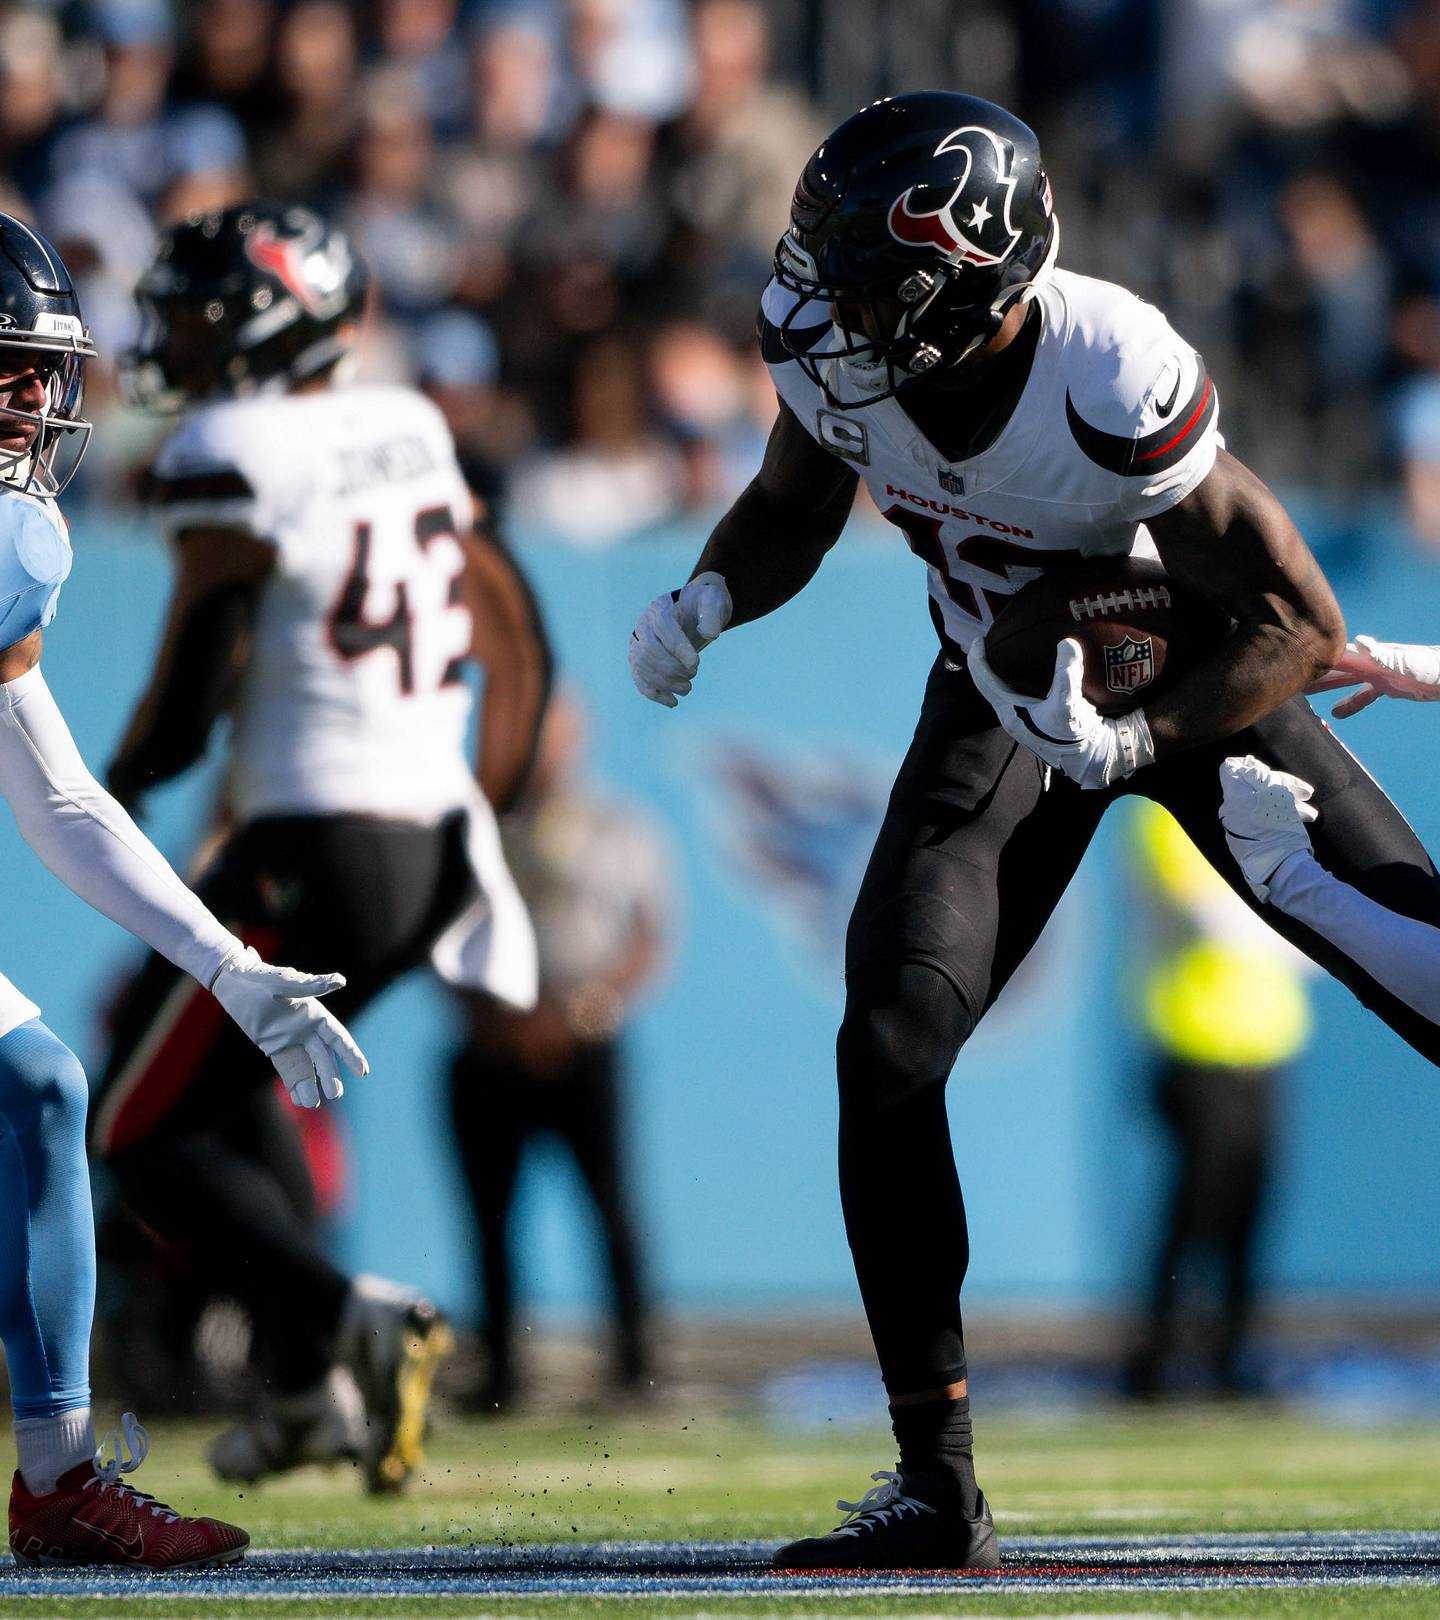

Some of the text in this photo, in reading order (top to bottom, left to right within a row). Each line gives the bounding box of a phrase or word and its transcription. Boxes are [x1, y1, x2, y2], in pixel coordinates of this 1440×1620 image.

[820, 414, 864, 454] C
[886, 484, 1035, 540] HOUSTON
[1111, 661, 1149, 688] NFL
